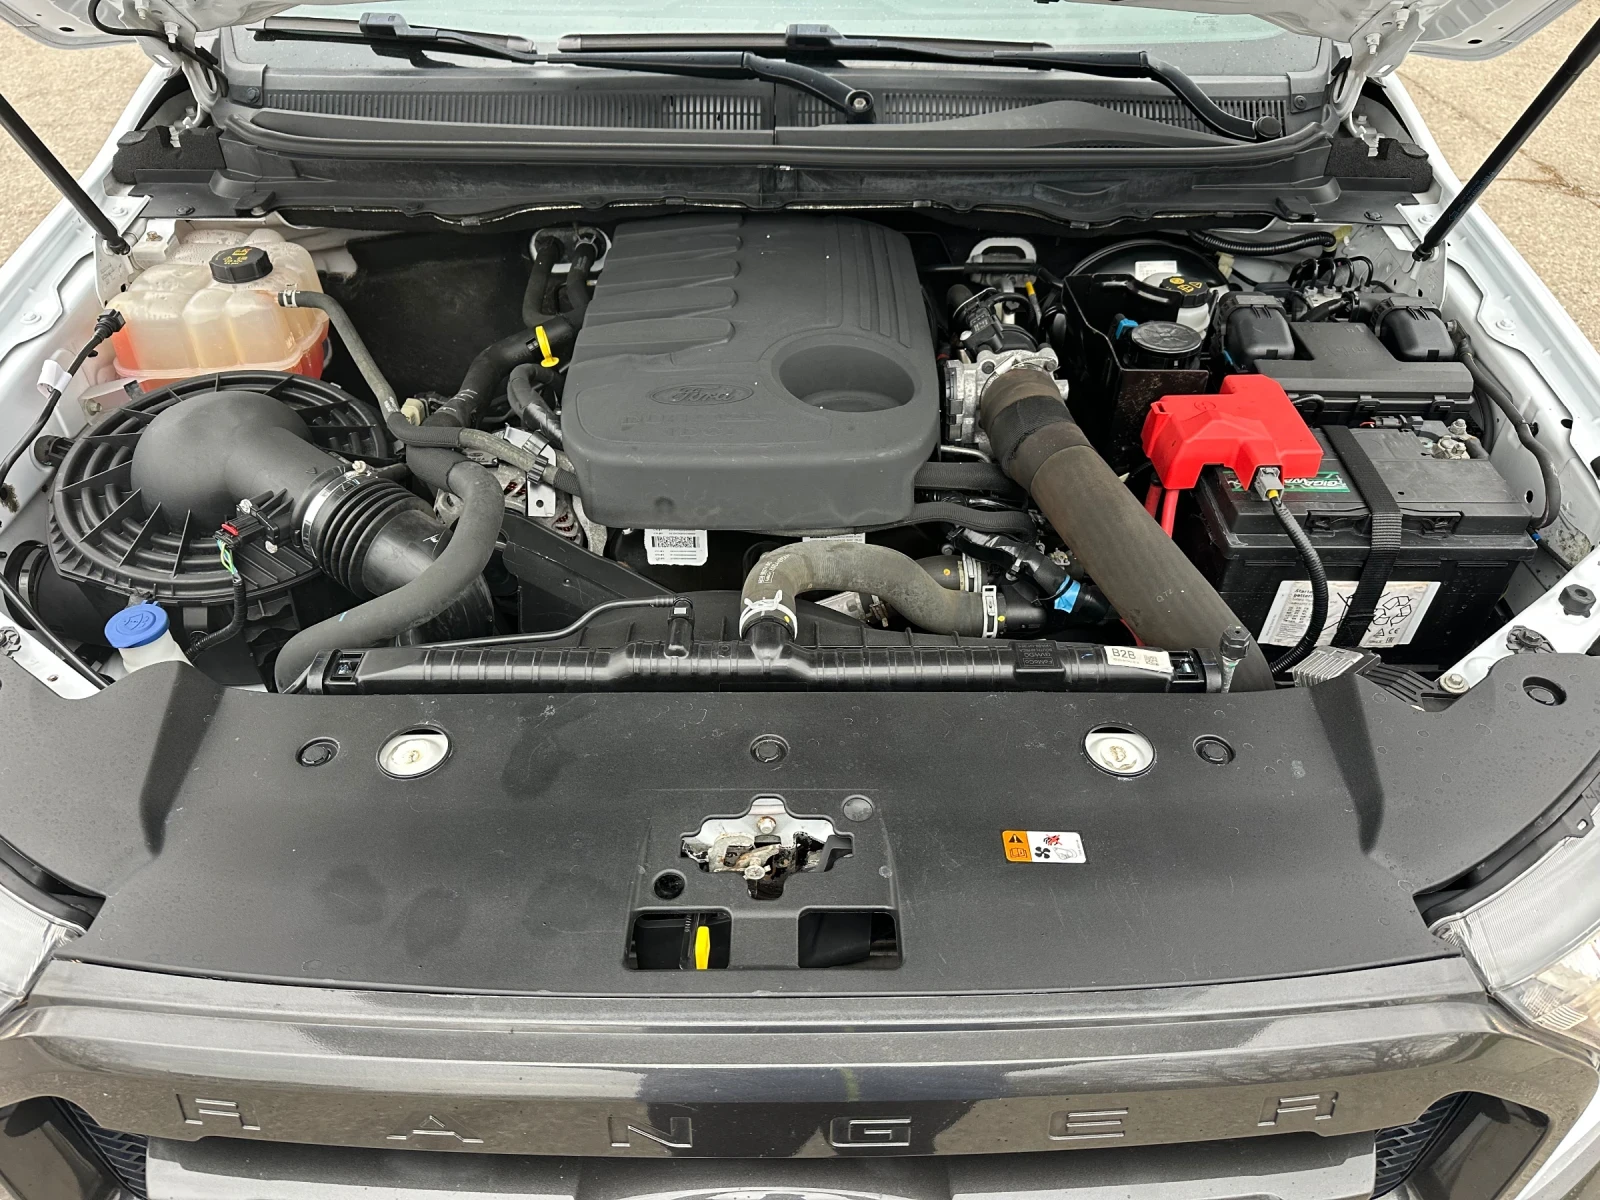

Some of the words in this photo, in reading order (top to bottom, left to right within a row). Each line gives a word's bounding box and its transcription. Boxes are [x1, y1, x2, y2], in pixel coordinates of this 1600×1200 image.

[671, 386, 738, 401] Ford
[1112, 648, 1136, 659] B2B
[176, 1091, 1338, 1148] RANGER
